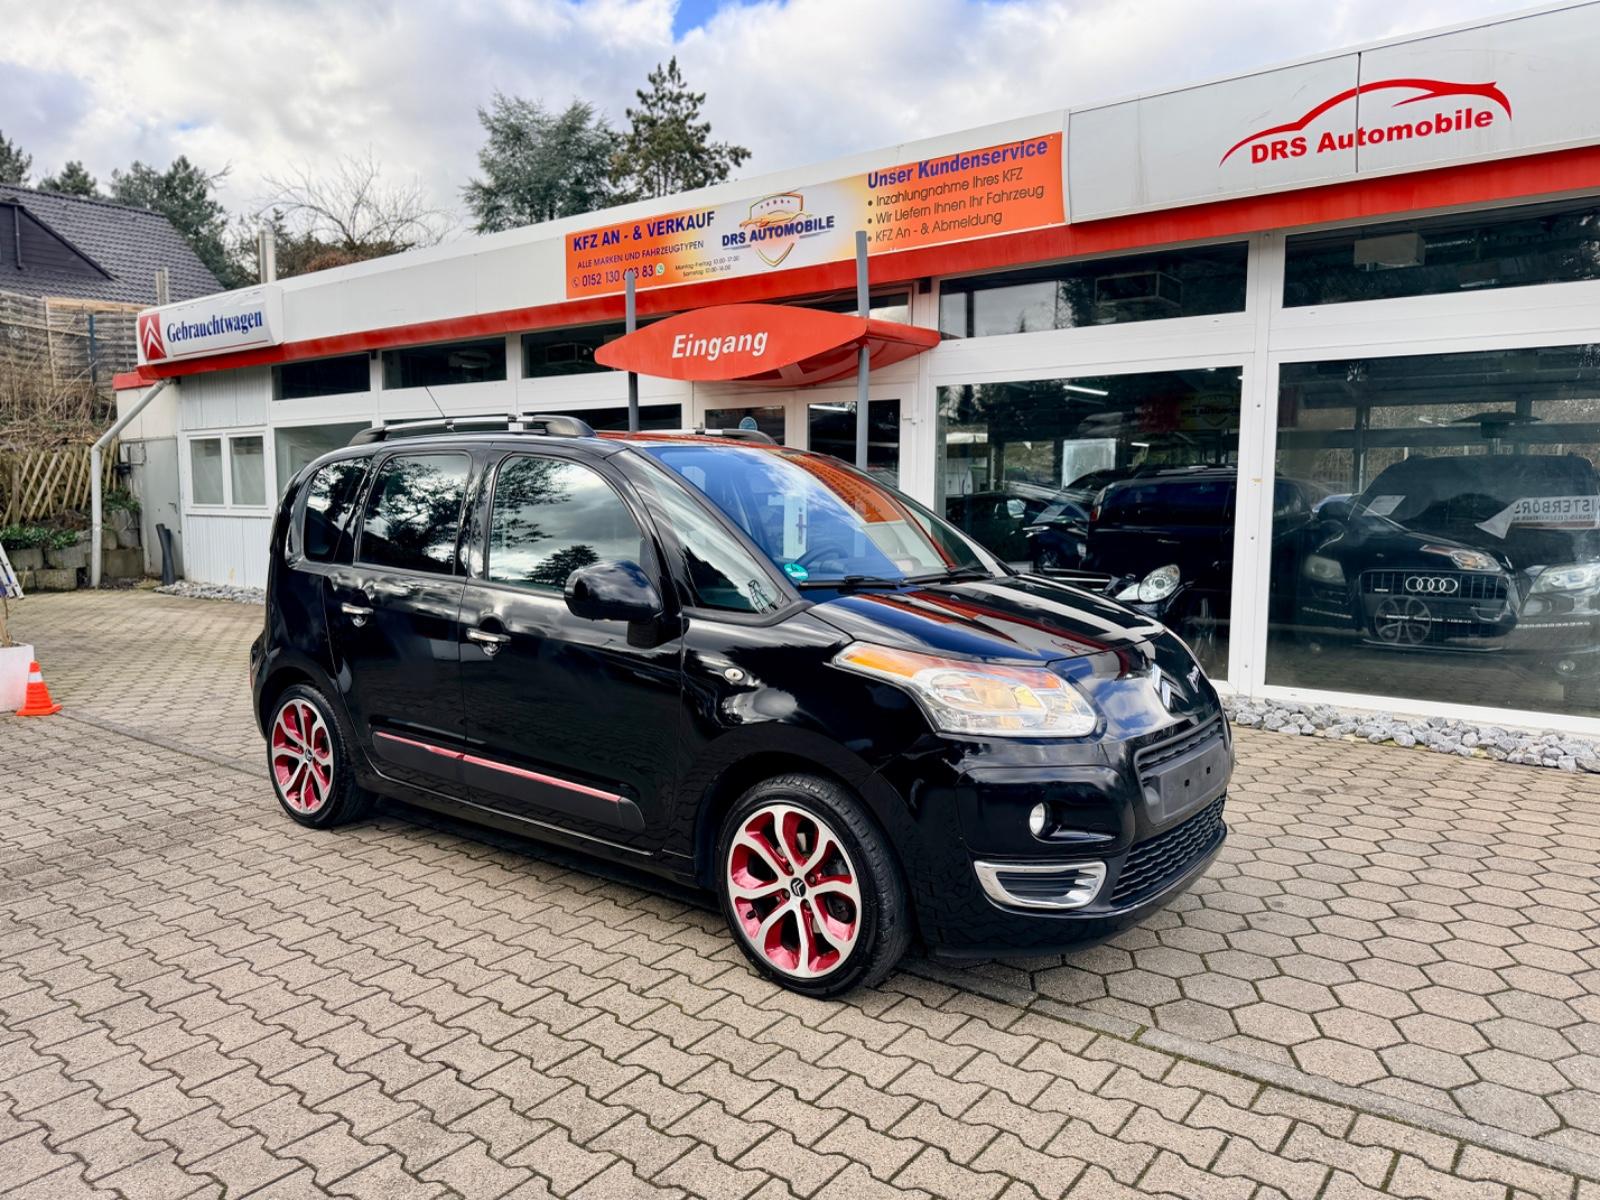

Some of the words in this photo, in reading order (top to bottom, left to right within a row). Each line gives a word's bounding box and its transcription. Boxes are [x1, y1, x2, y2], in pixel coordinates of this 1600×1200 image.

[1251, 136, 1307, 164] DRS
[1316, 107, 1493, 153] Automobile
[868, 168, 913, 189] Unser
[918, 140, 1048, 178] Kundenservice
[877, 180, 969, 206] Inzahlungnahme
[973, 173, 999, 188] Ihres
[1002, 167, 1023, 183] KFZ
[876, 209, 892, 224] Wir
[895, 202, 931, 222] Liefern
[934, 197, 966, 213] Ihnen
[970, 193, 983, 207] Ihr
[987, 184, 1045, 205] Fahrzeug
[573, 233, 598, 252] KFZ
[601, 230, 620, 247] AN
[632, 225, 642, 241] &
[647, 211, 715, 237] VERKAUF
[722, 231, 746, 247] DRS
[749, 215, 835, 243] AUTOMOBILE
[875, 228, 893, 243] KFZ
[896, 225, 911, 240] An
[920, 222, 929, 235] &
[932, 211, 1003, 233] Abmeldung
[577, 257, 593, 269] ALLE
[594, 254, 623, 266] MARKEN
[626, 251, 641, 262] UND
[642, 240, 704, 259] FAHRZEUGTYPEN
[582, 273, 602, 287] 0152
[605, 269, 620, 284] 130
[642, 264, 654, 277] 83
[166, 310, 263, 343] Gebrauchtwagen
[672, 331, 768, 361] Eingang
